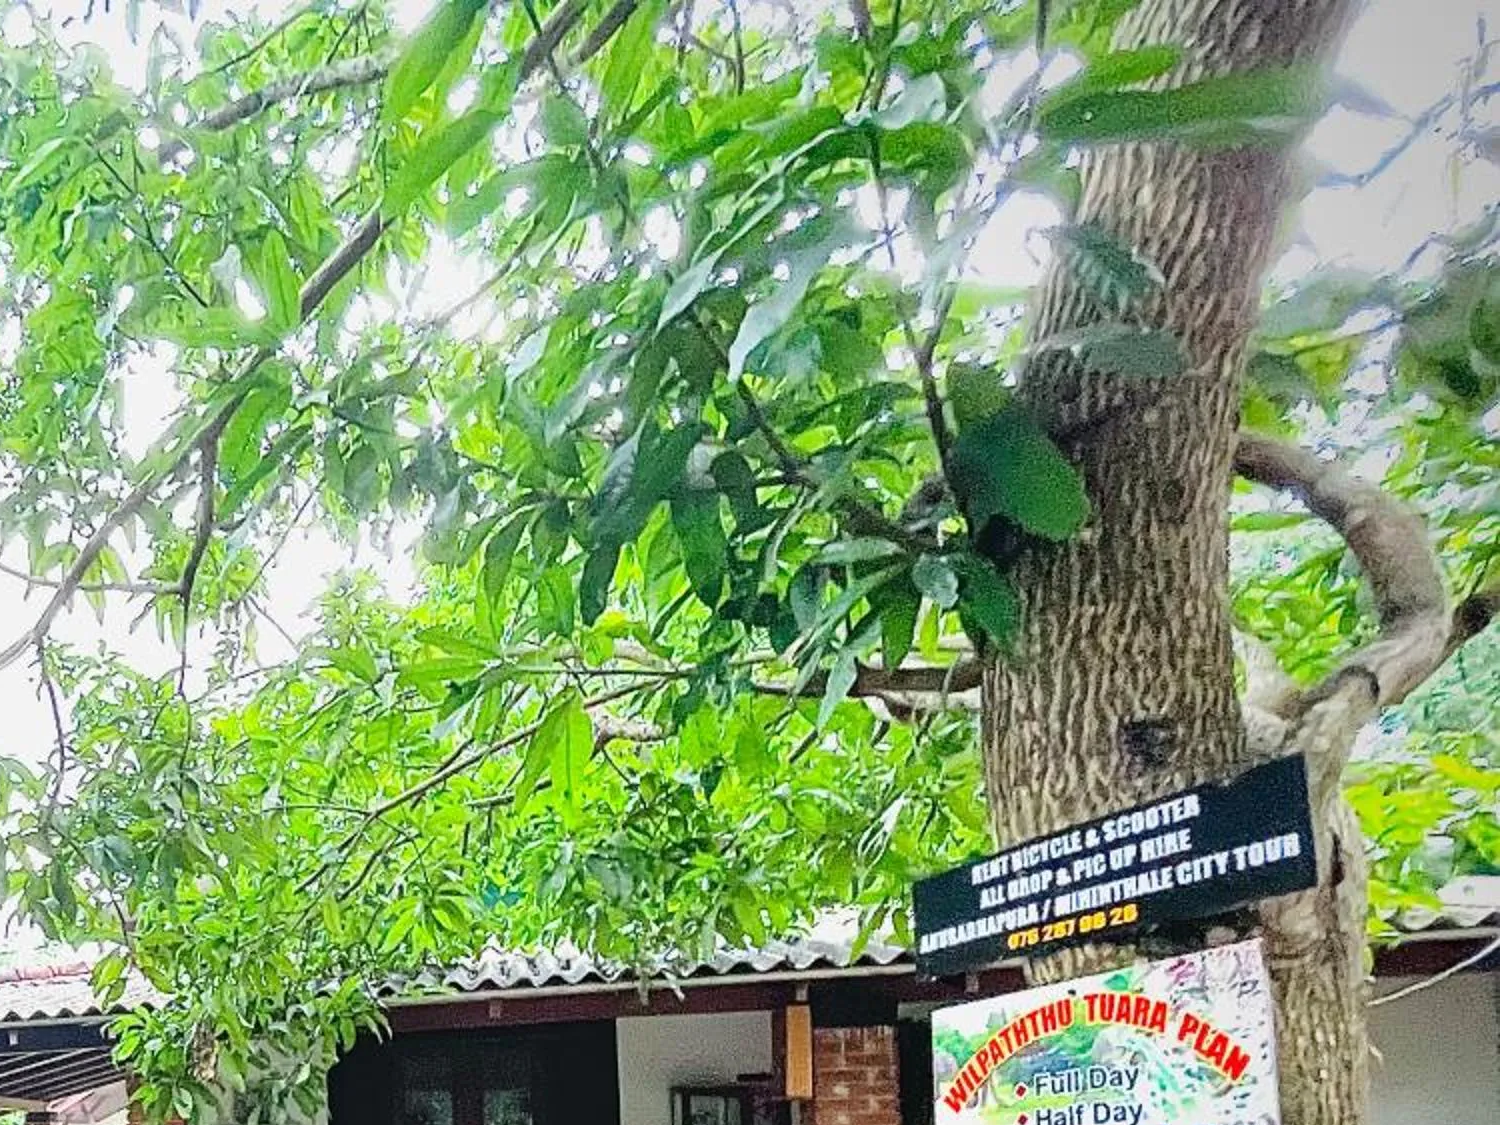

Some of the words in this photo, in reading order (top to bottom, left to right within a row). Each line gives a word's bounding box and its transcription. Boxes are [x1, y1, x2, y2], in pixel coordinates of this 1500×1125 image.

[972, 857, 1011, 885] RENT
[1010, 831, 1082, 873] BICYCLE
[1085, 829, 1101, 848] &
[1102, 794, 1200, 842] SCOOTER
[1175, 851, 1229, 886] CITY
[1232, 832, 1301, 871] TOUR
[979, 883, 1006, 909] ALL
[1007, 869, 1052, 901] DROP
[1056, 867, 1072, 886] &
[1073, 853, 1107, 882] PIC
[1109, 843, 1137, 871] UP
[1084, 994, 1167, 1033] TUARA
[1177, 1013, 1251, 1081] PLAN
[1035, 1071, 1084, 1096] Full
[1089, 1066, 1140, 1092] Day
